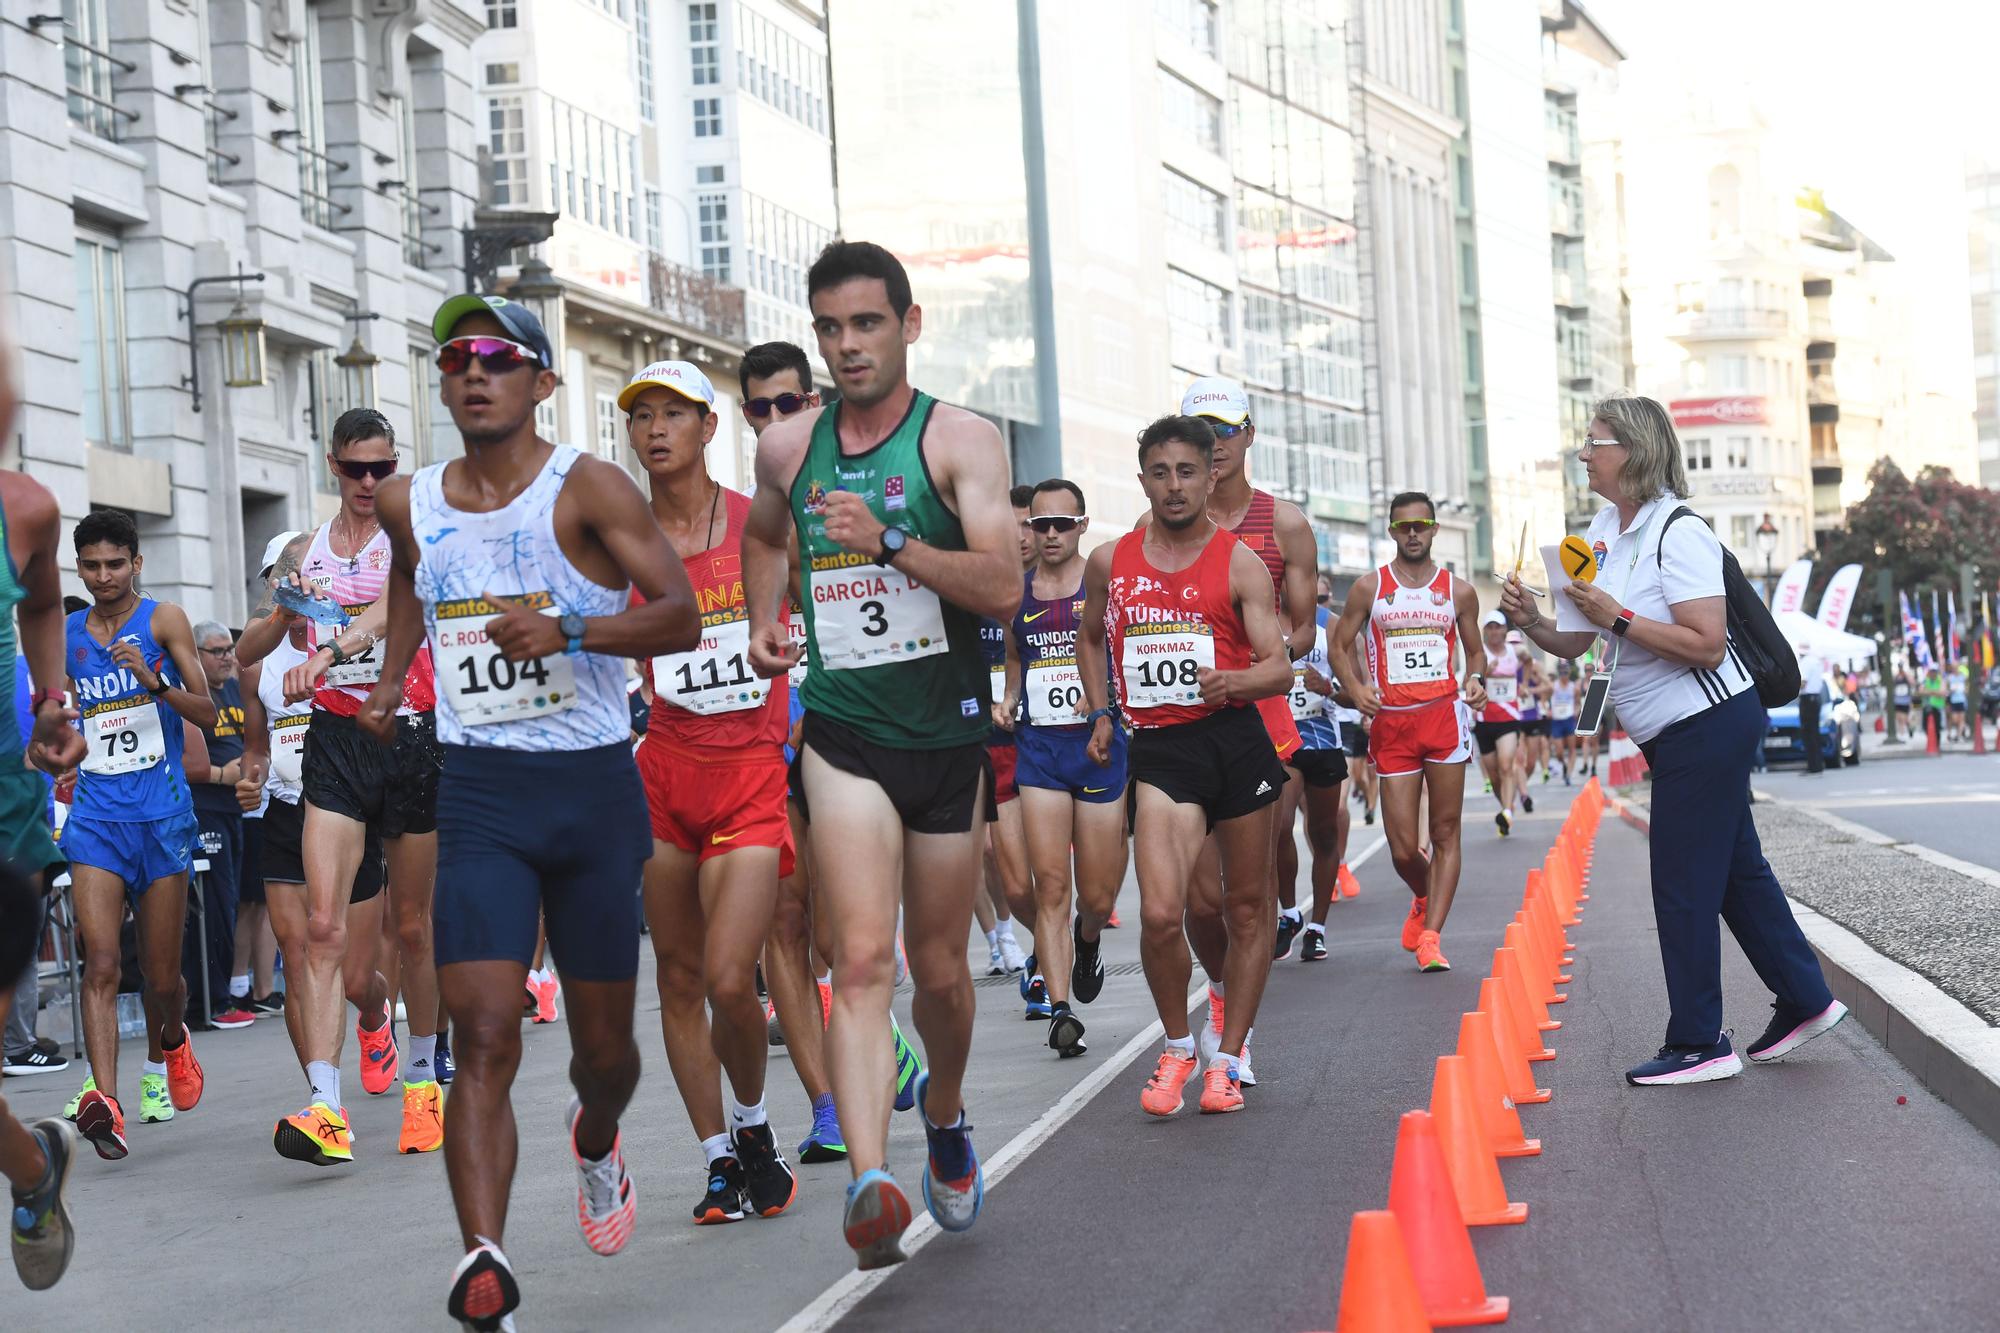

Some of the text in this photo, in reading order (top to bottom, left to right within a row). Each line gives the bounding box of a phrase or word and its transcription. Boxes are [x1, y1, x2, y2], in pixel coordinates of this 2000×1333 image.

[640, 367, 682, 381] CHINA
[1193, 393, 1229, 404] CHINA
[814, 577, 889, 603] GARCIA
[702, 606, 750, 627] nes2
[860, 600, 889, 637] 3
[1381, 611, 1449, 623] UCAM ATHLEO
[980, 628, 1004, 641] CAR
[1125, 622, 1210, 637] cantones22
[699, 637, 718, 651] IU
[1026, 630, 1077, 647] FUNDAC
[1040, 645, 1076, 659] BARC
[1136, 641, 1195, 655] KORKMAZ
[1029, 657, 1076, 669] cantone
[1404, 651, 1432, 669] 51
[458, 652, 550, 695] 104
[675, 653, 754, 695] 111
[1051, 670, 1081, 682] LÓPEZ
[1137, 659, 1199, 687] 108
[1048, 686, 1082, 708] 60
[101, 716, 128, 729] AMIT
[100, 730, 139, 757] 79
